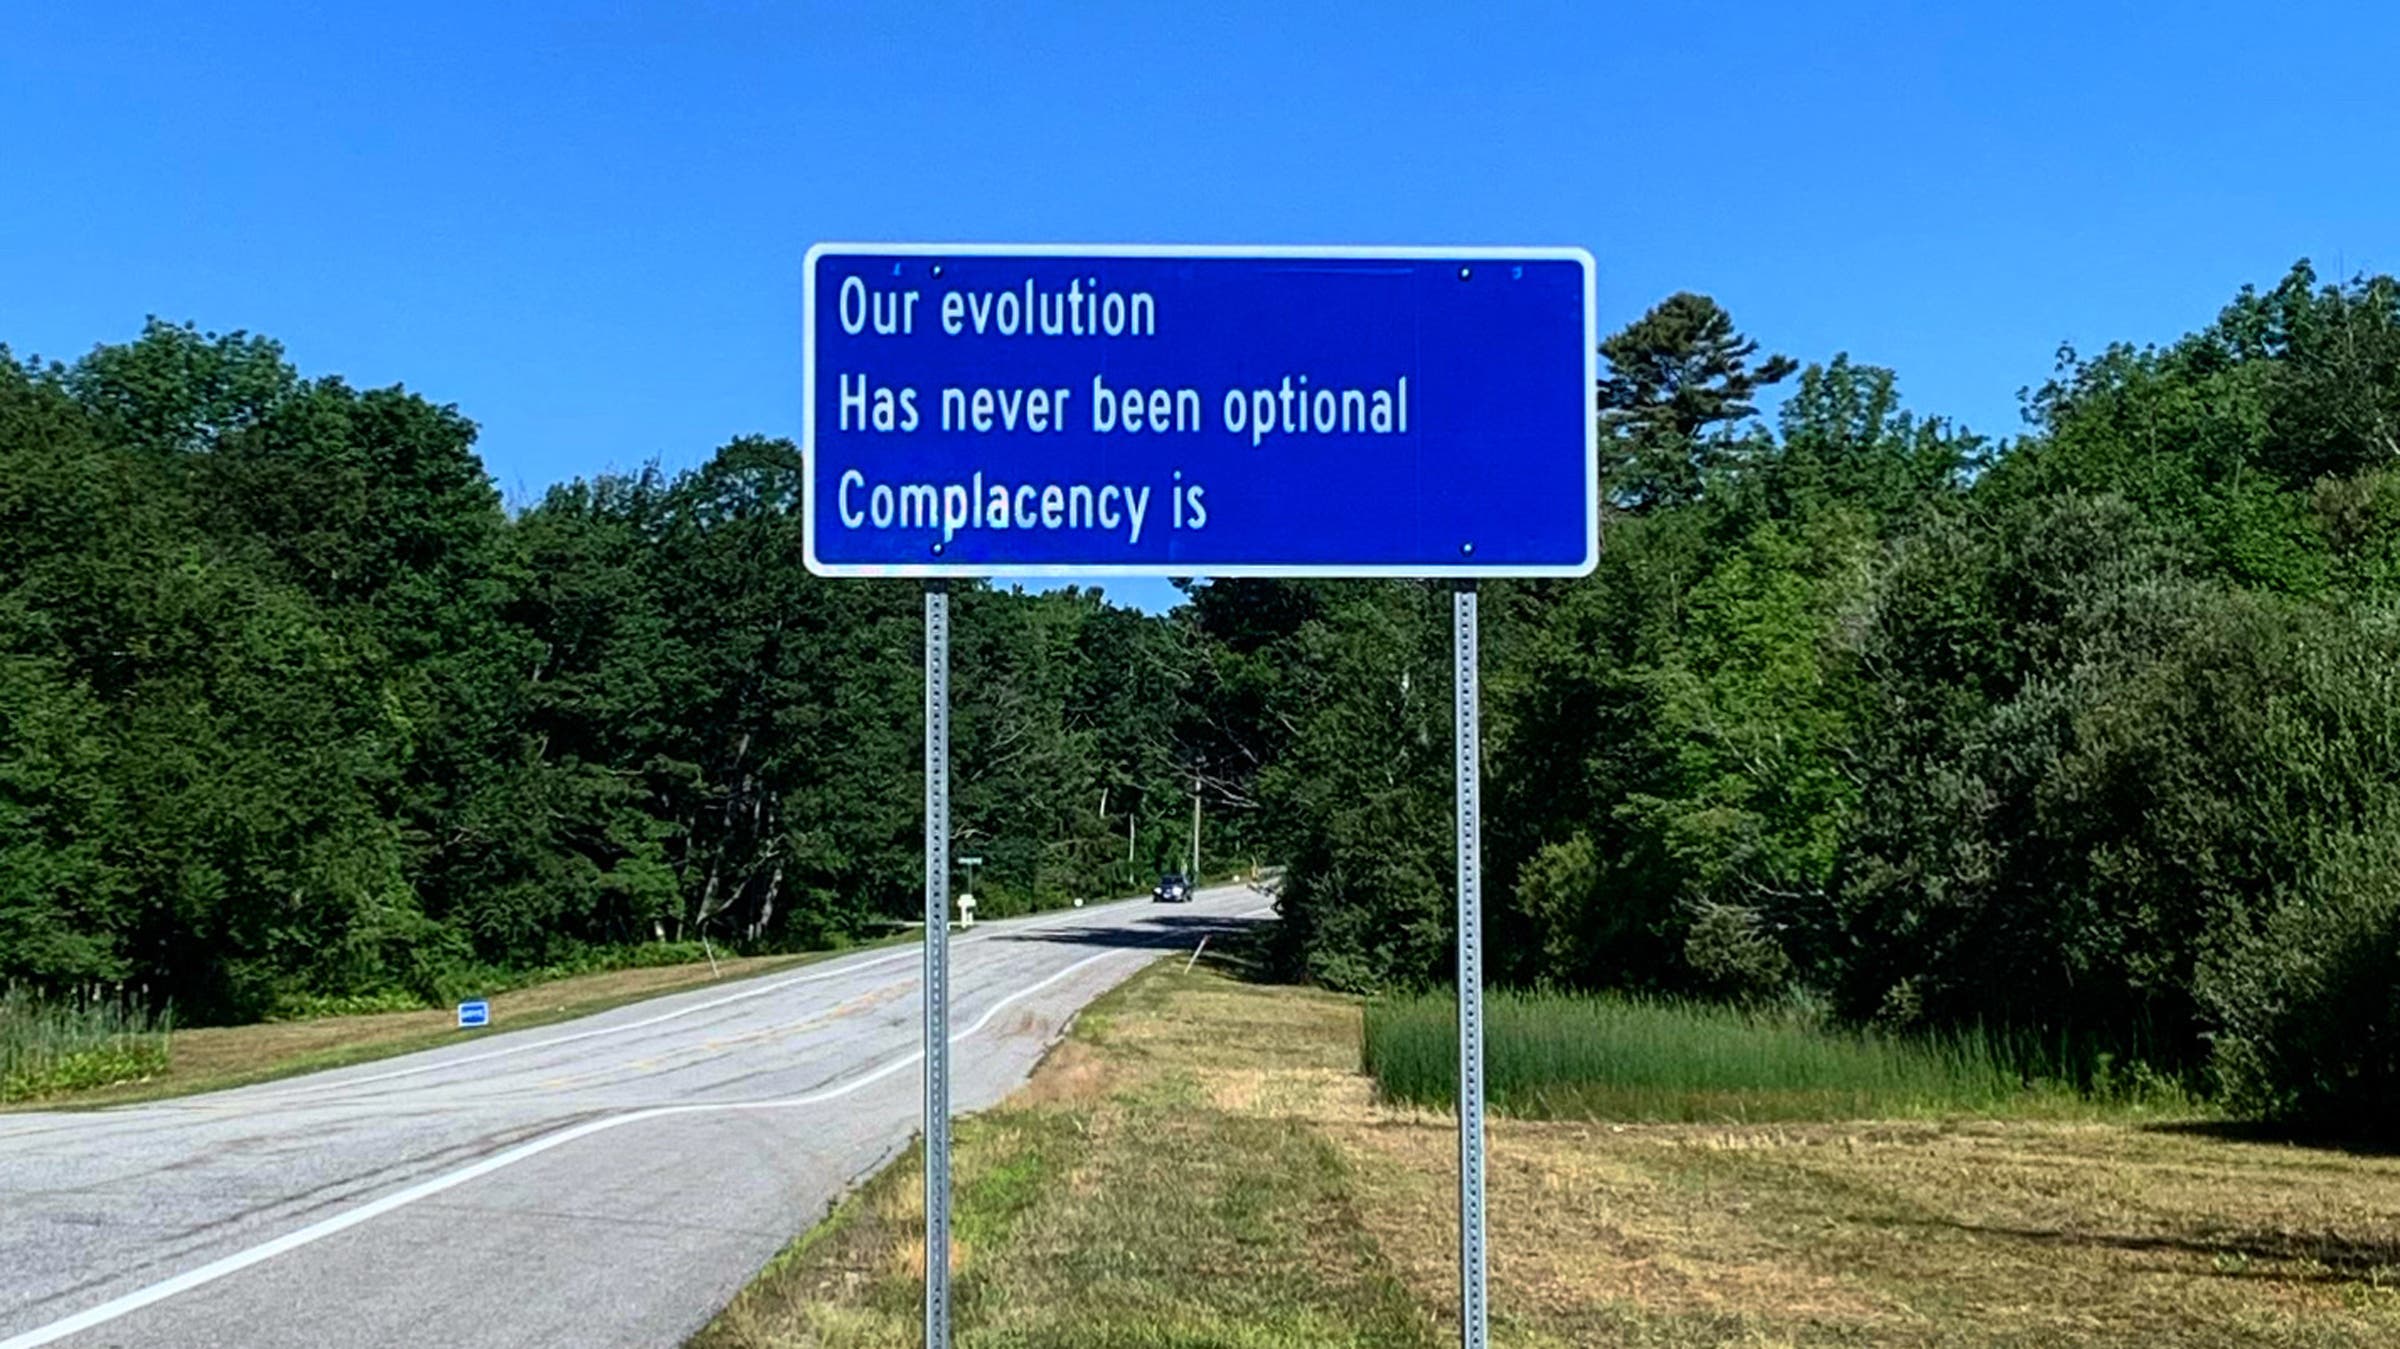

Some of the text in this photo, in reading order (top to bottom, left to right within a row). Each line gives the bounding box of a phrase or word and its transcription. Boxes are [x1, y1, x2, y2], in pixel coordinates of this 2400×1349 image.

[841, 277, 1153, 335] Our evolution
[841, 374, 1405, 444] Has never been optional
[840, 470, 1206, 542] Complacency is
